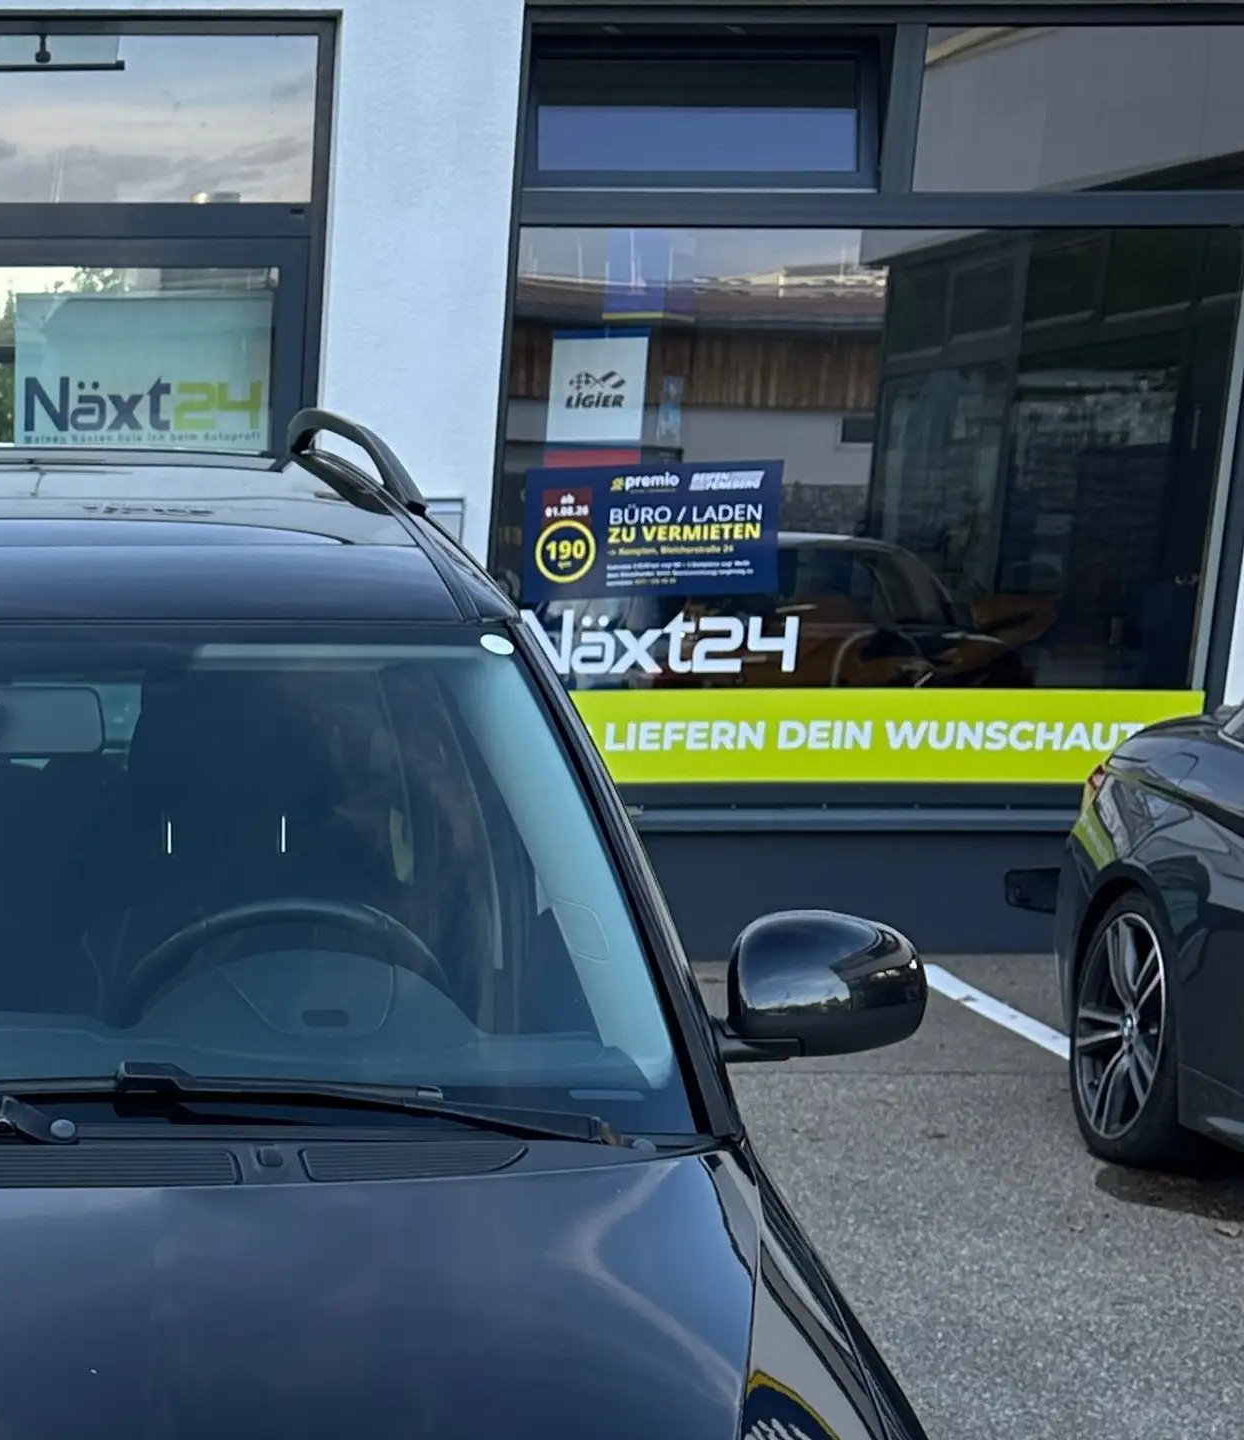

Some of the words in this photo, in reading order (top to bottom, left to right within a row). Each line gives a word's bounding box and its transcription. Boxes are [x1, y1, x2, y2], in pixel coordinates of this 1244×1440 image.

[24, 376, 262, 432] Näxt24
[625, 471, 680, 491] premio
[609, 504, 672, 525] BÜRO
[677, 505, 687, 523] /
[692, 503, 763, 523] LADEN
[608, 527, 636, 544] ZU
[642, 523, 761, 542] VERMIETEN
[545, 539, 586, 561] 190
[520, 609, 800, 674] Näxt24
[604, 720, 765, 751] LIEFERN
[777, 720, 873, 751] DEIN
